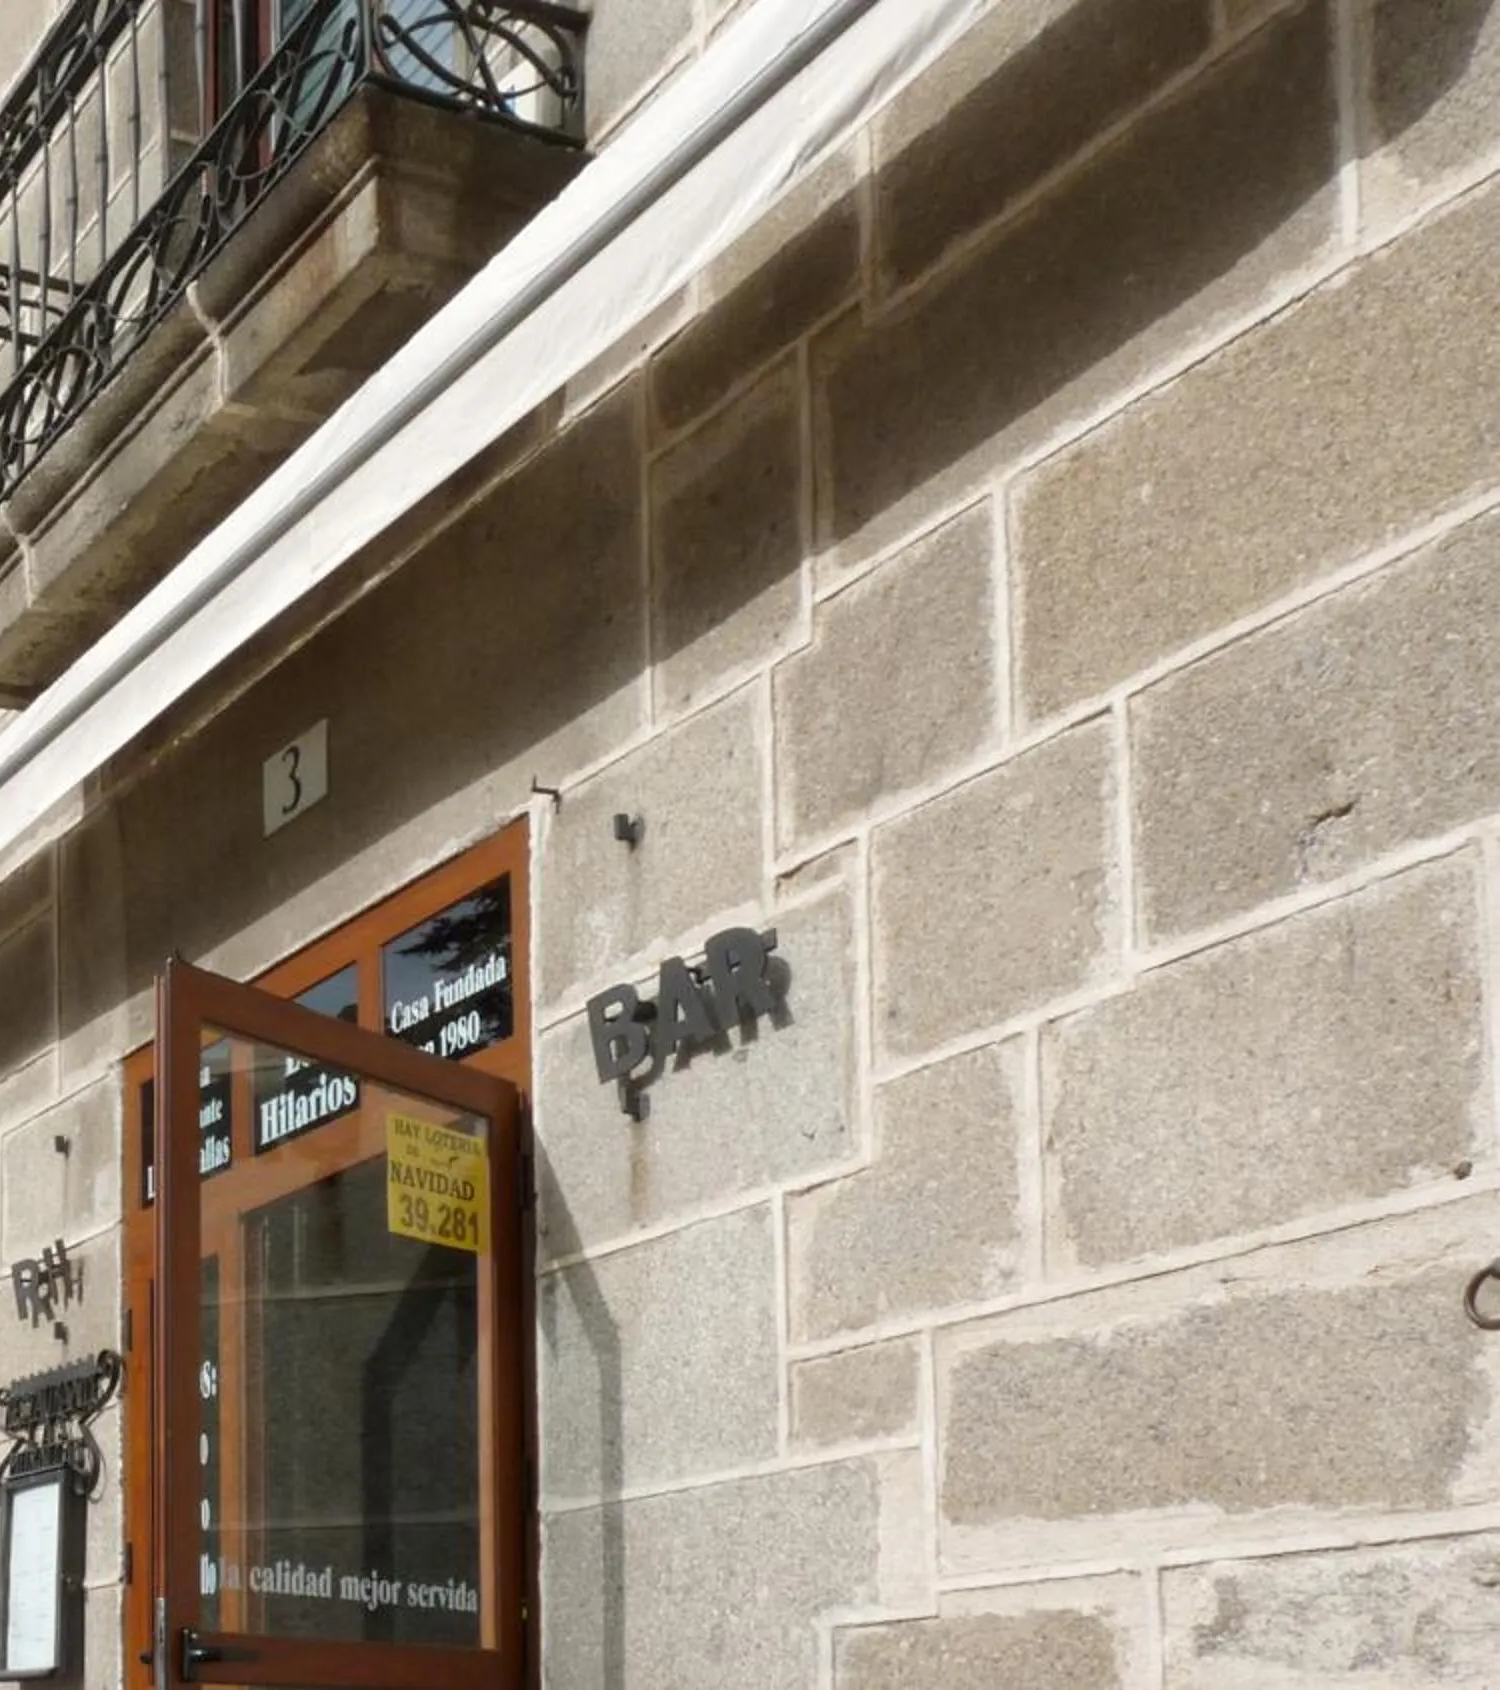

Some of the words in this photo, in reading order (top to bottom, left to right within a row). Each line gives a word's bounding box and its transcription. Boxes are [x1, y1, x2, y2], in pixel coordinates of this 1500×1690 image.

[282, 745, 302, 815] 3
[391, 996, 429, 1033] Casa
[434, 953, 506, 1012] Fundada
[586, 927, 775, 1085] BAR
[439, 1010, 481, 1057] 1980
[260, 1072, 357, 1146] Hilarios
[389, 1159, 475, 1201] NAVIDAD
[400, 1194, 478, 1246] 39.281
[250, 1560, 332, 1599] calidad
[340, 1570, 401, 1612] mejor
[407, 1577, 479, 1614] servida
